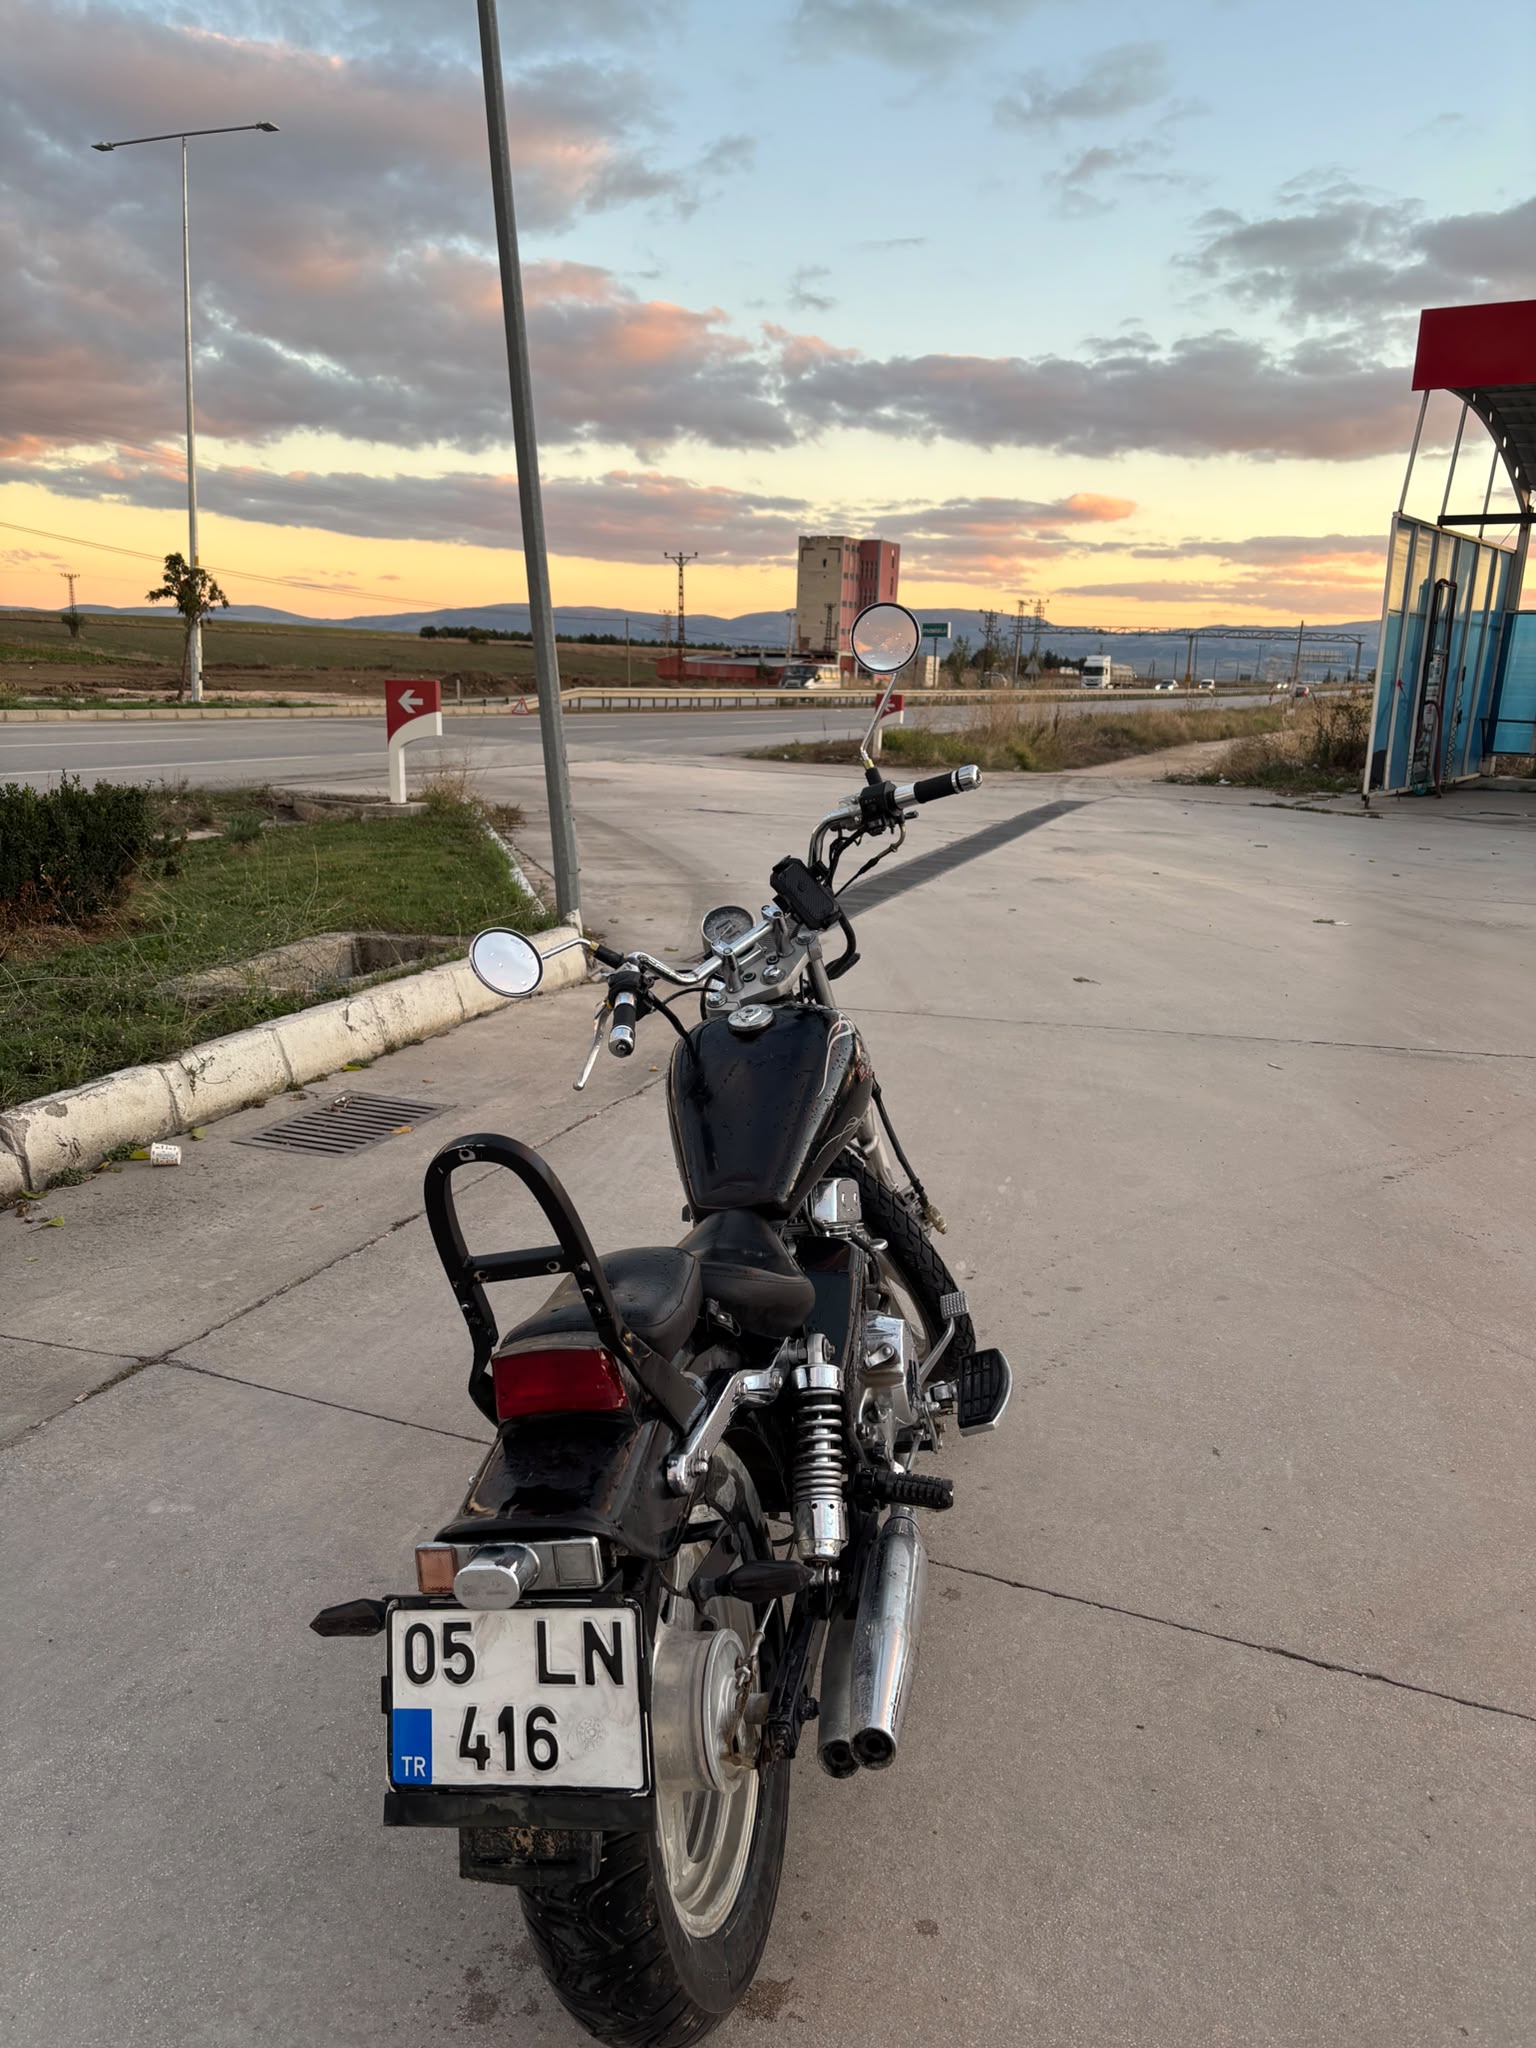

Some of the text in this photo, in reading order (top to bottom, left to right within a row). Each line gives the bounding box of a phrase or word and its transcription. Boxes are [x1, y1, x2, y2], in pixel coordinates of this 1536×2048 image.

[405, 1620, 624, 1685] 05 LN
[401, 1756, 426, 1777] TR
[459, 1705, 558, 1771] 416
